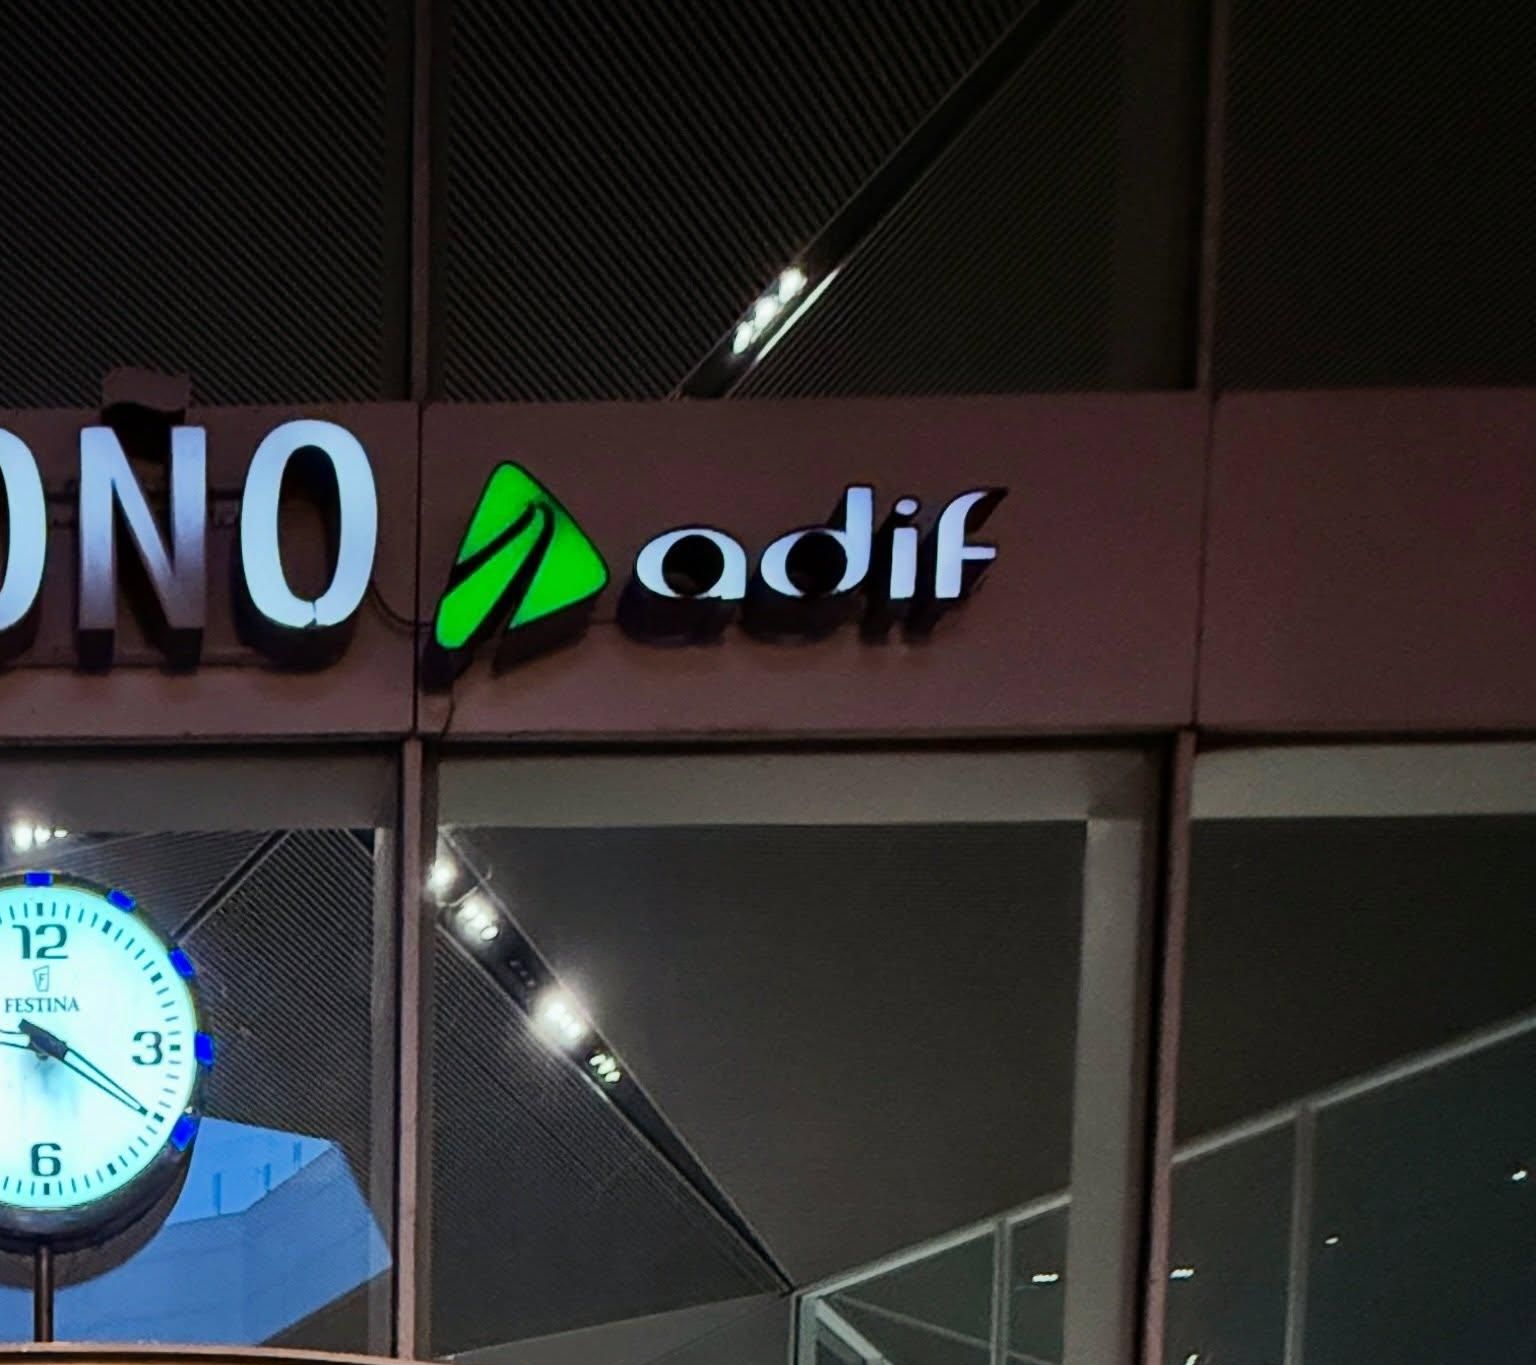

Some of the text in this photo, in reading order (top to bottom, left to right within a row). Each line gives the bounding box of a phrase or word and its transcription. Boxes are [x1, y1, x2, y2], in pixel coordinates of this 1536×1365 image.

[635, 485, 999, 601] adif
[12, 923, 69, 960] 12
[4, 996, 80, 1013] FESTINA
[132, 1030, 163, 1066] 3
[30, 1142, 62, 1177] 6
